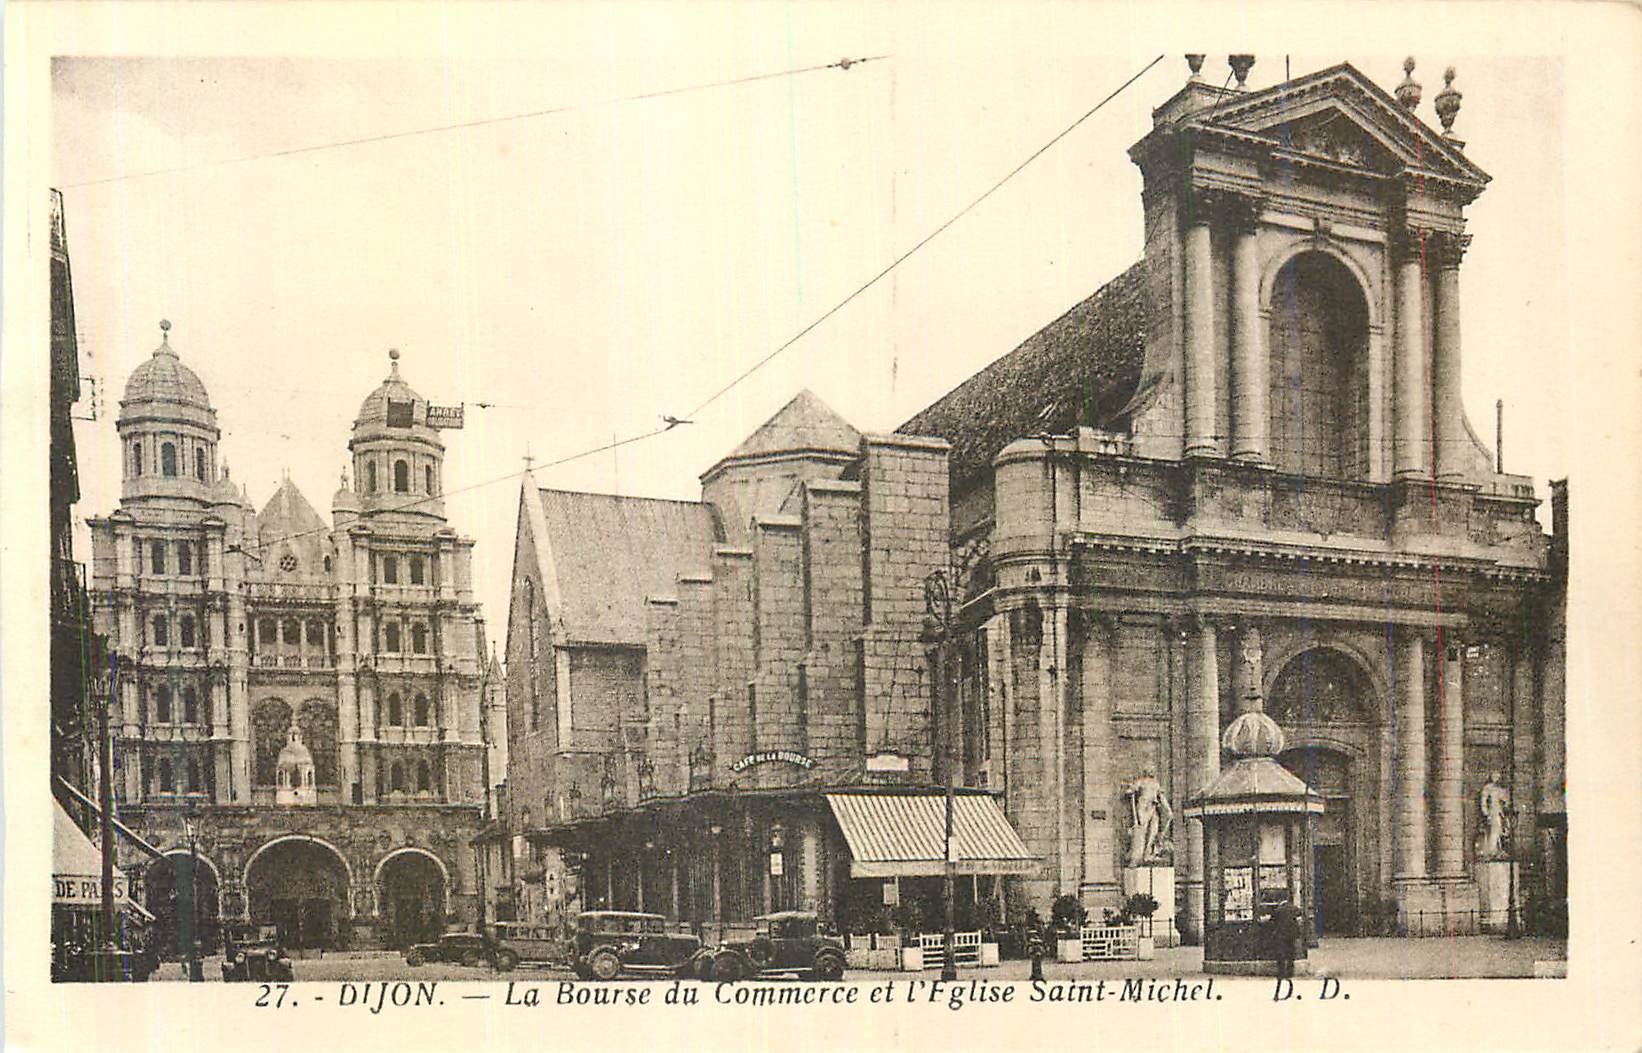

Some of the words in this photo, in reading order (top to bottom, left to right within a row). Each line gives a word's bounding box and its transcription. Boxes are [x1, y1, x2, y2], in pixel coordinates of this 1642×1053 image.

[778, 751, 812, 769] BOURSE
[55, 880, 76, 898] DE
[82, 881, 124, 899] PAS
